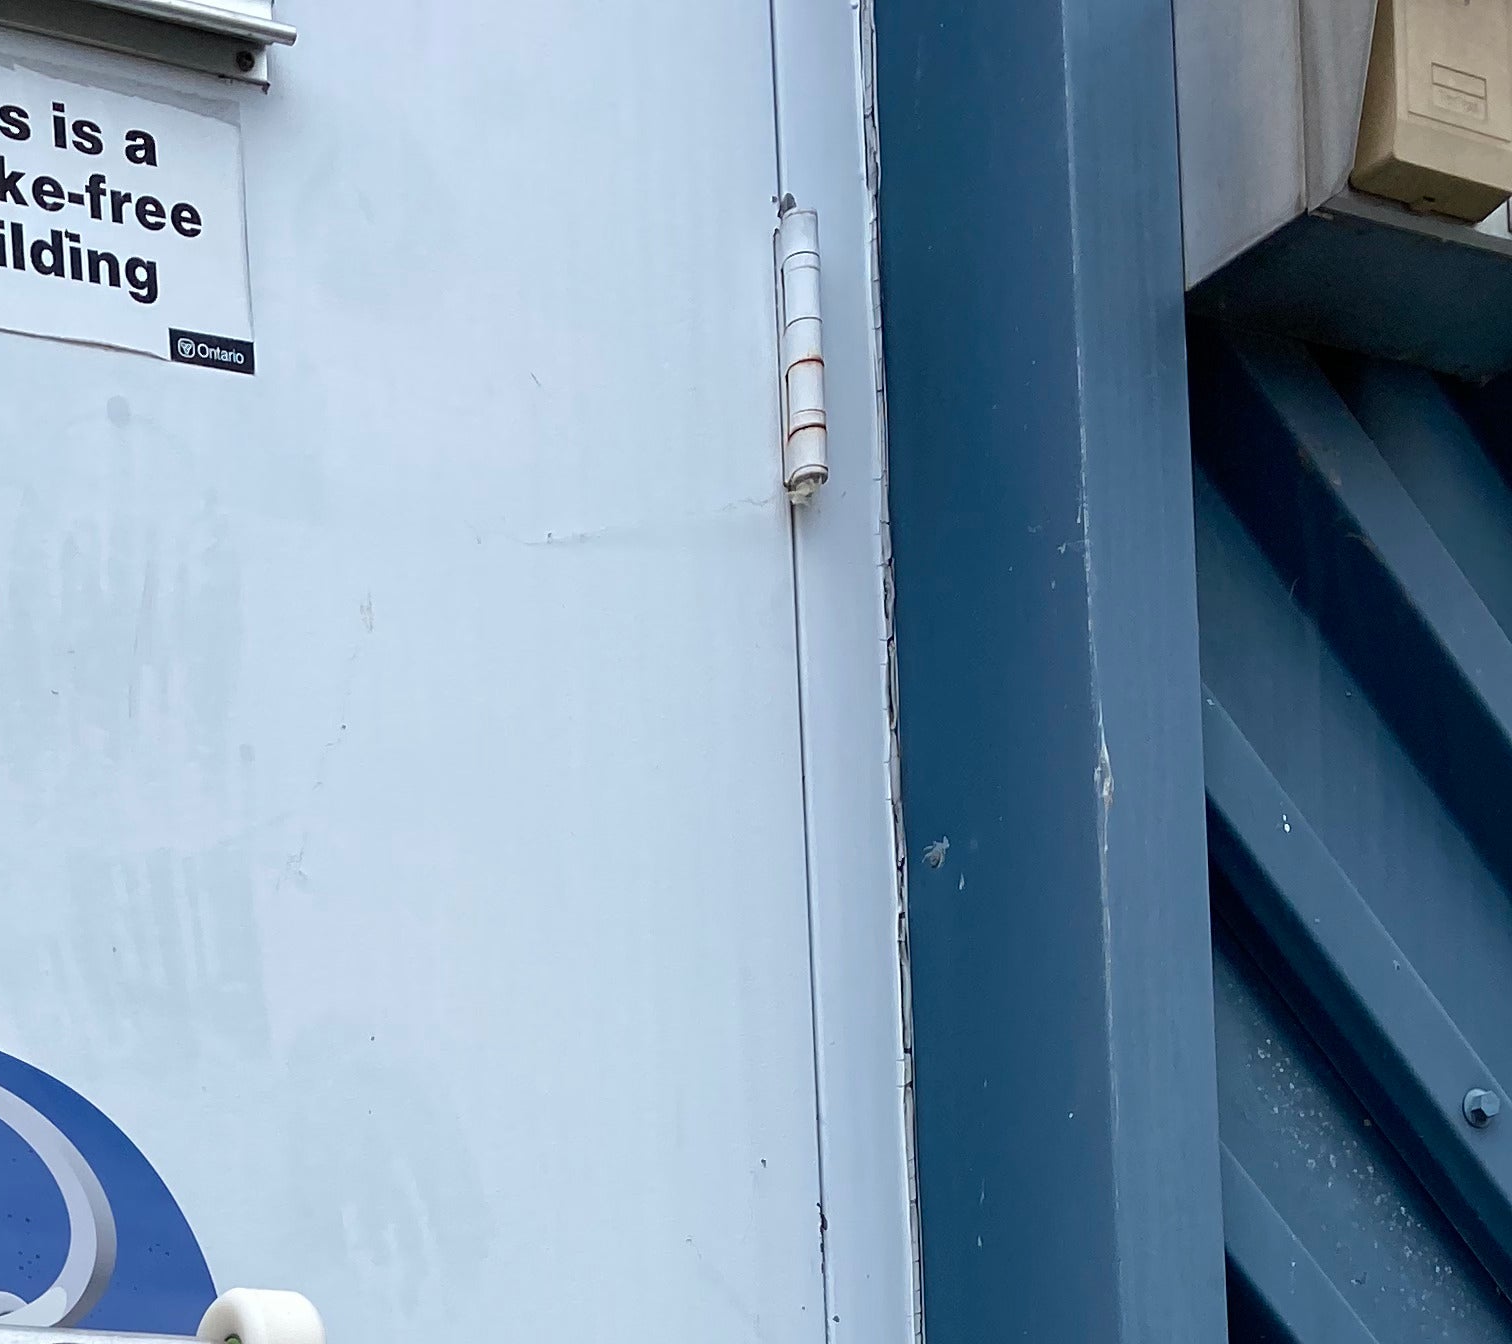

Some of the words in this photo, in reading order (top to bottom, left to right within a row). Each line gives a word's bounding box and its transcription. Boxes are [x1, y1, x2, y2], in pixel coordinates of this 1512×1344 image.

[52, 101, 104, 156] is
[124, 129, 158, 167] a
[197, 343, 245, 365] Ontario
